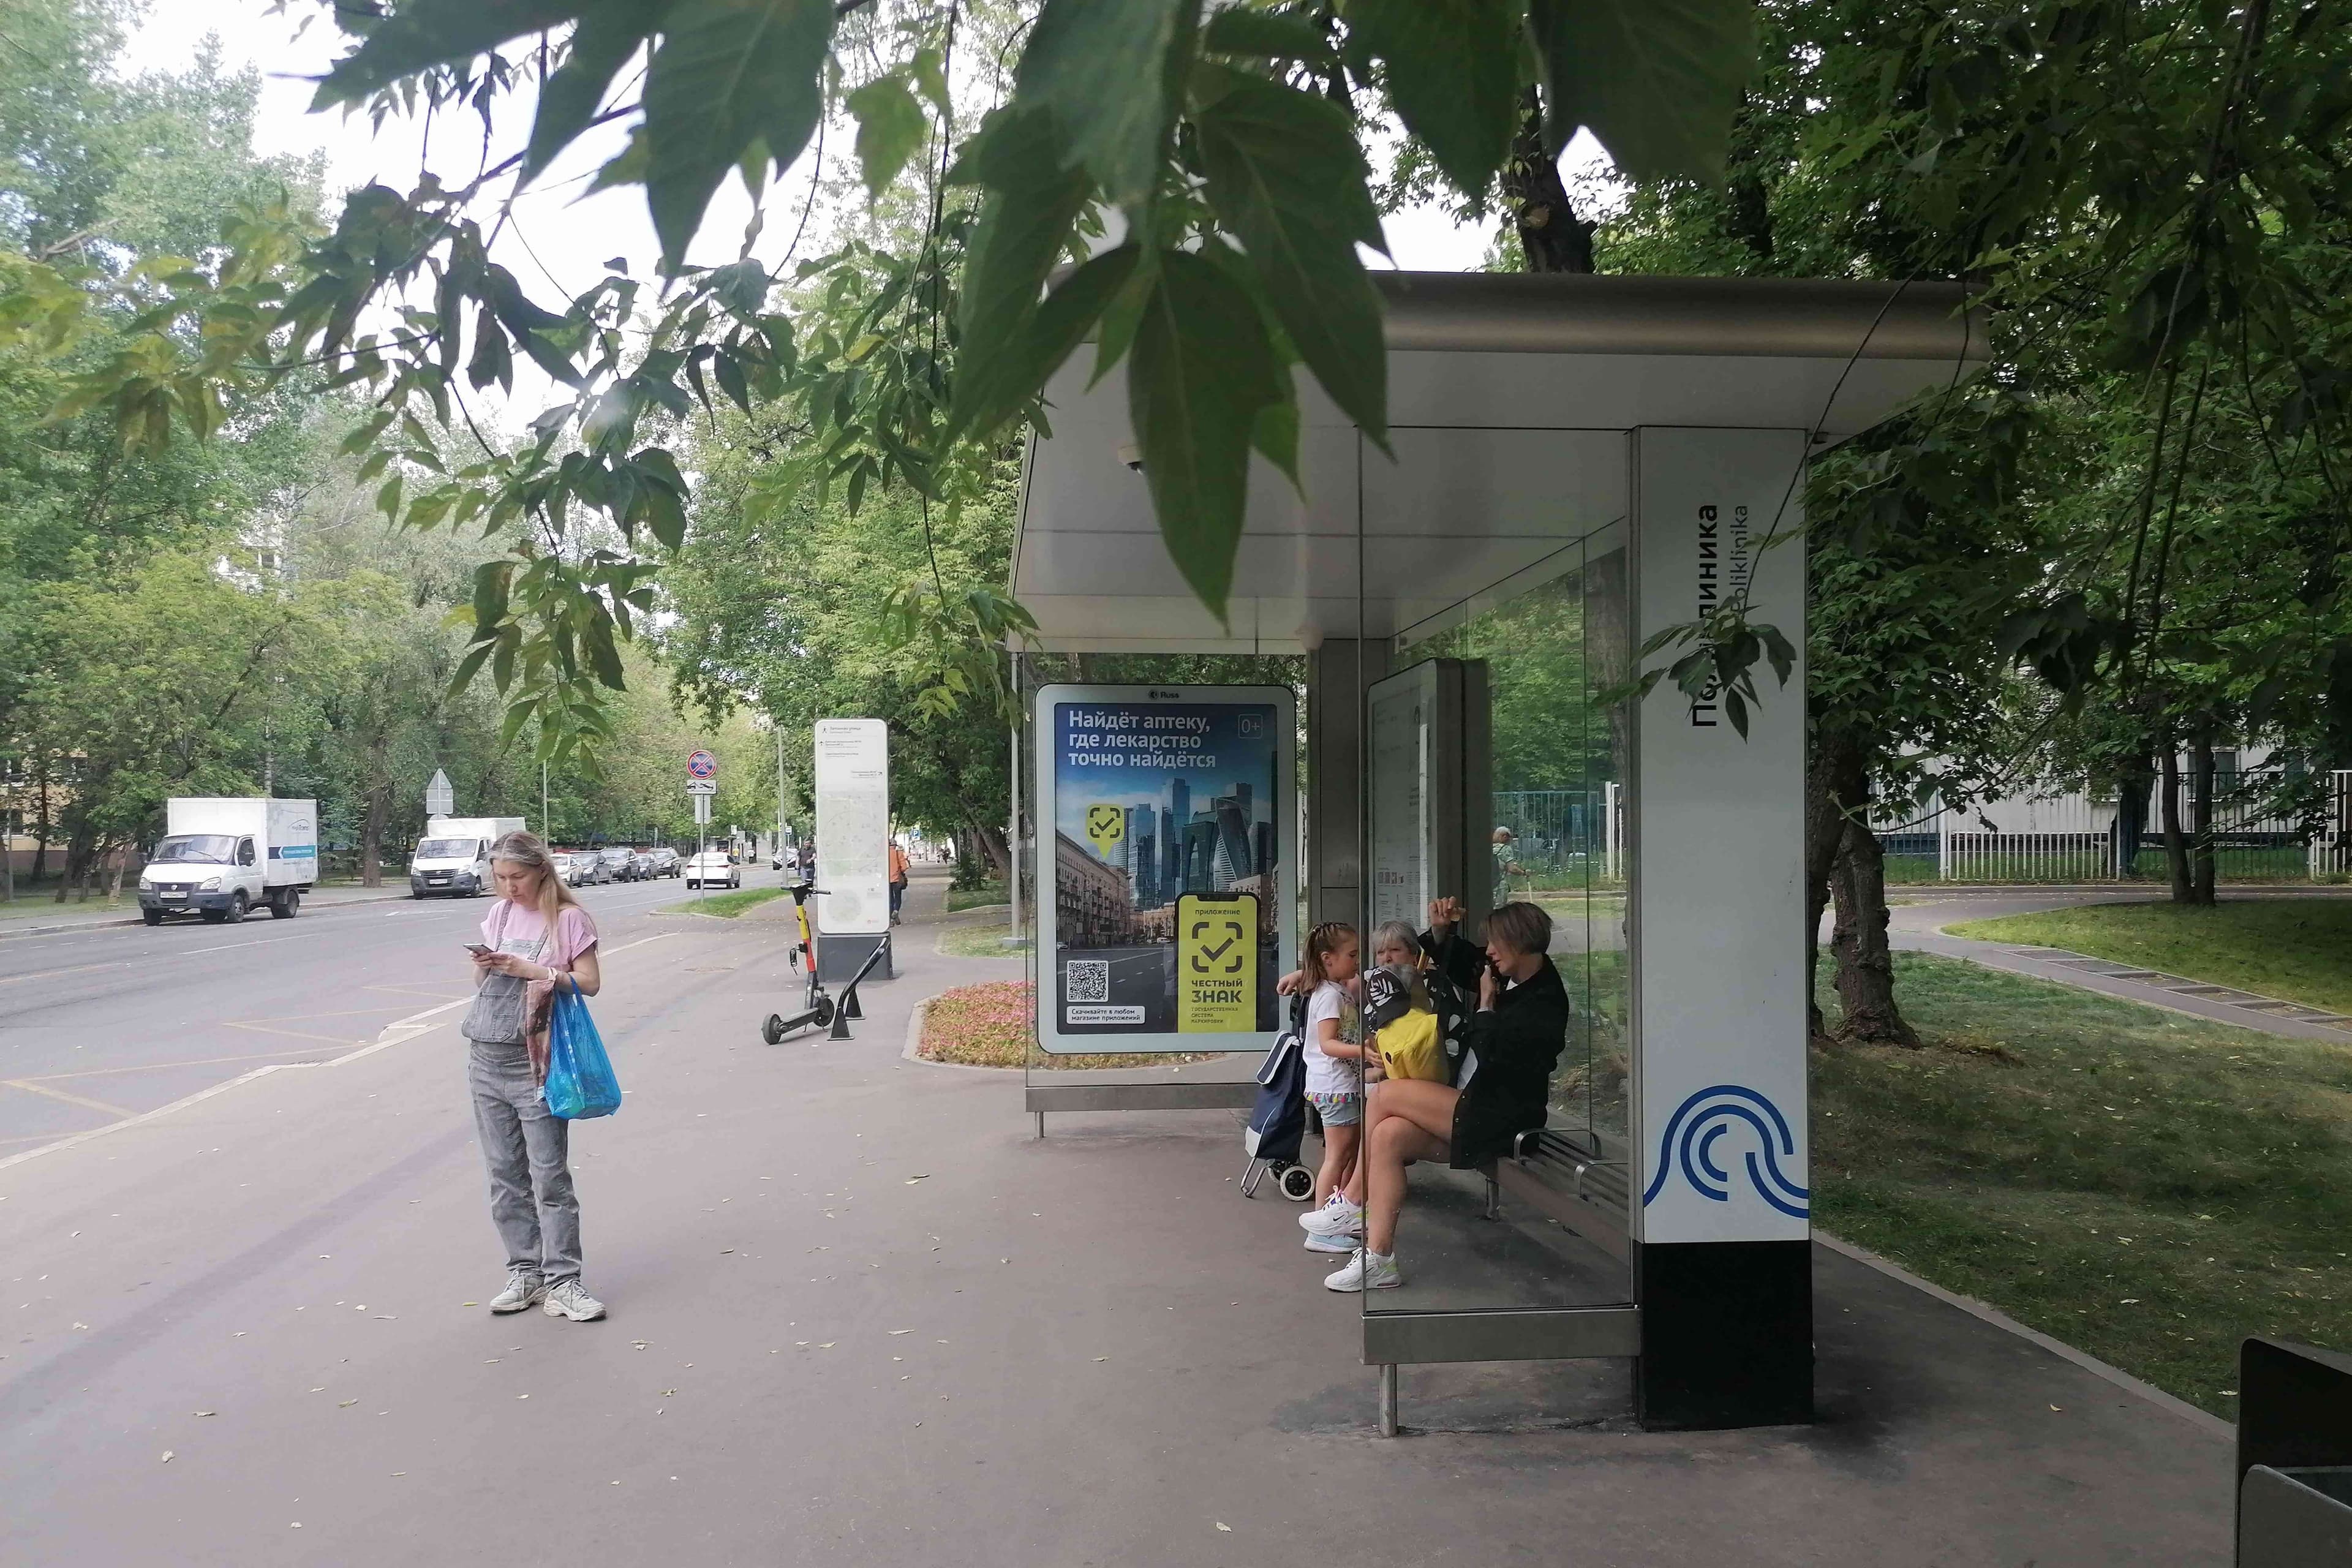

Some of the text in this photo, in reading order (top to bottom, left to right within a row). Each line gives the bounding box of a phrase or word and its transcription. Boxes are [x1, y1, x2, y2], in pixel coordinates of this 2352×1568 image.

[1692, 505, 1717, 726] Полиника
[1069, 710, 1210, 733] Найдёт аптеку,
[1241, 719, 1260, 733] 0+
[1069, 734, 1201, 752] где лекарство
[1068, 750, 1216, 769] точно найдётся
[1191, 978, 1243, 987] ЧЕСТНЫЙ
[1191, 990, 1242, 1003] ЗНАК
